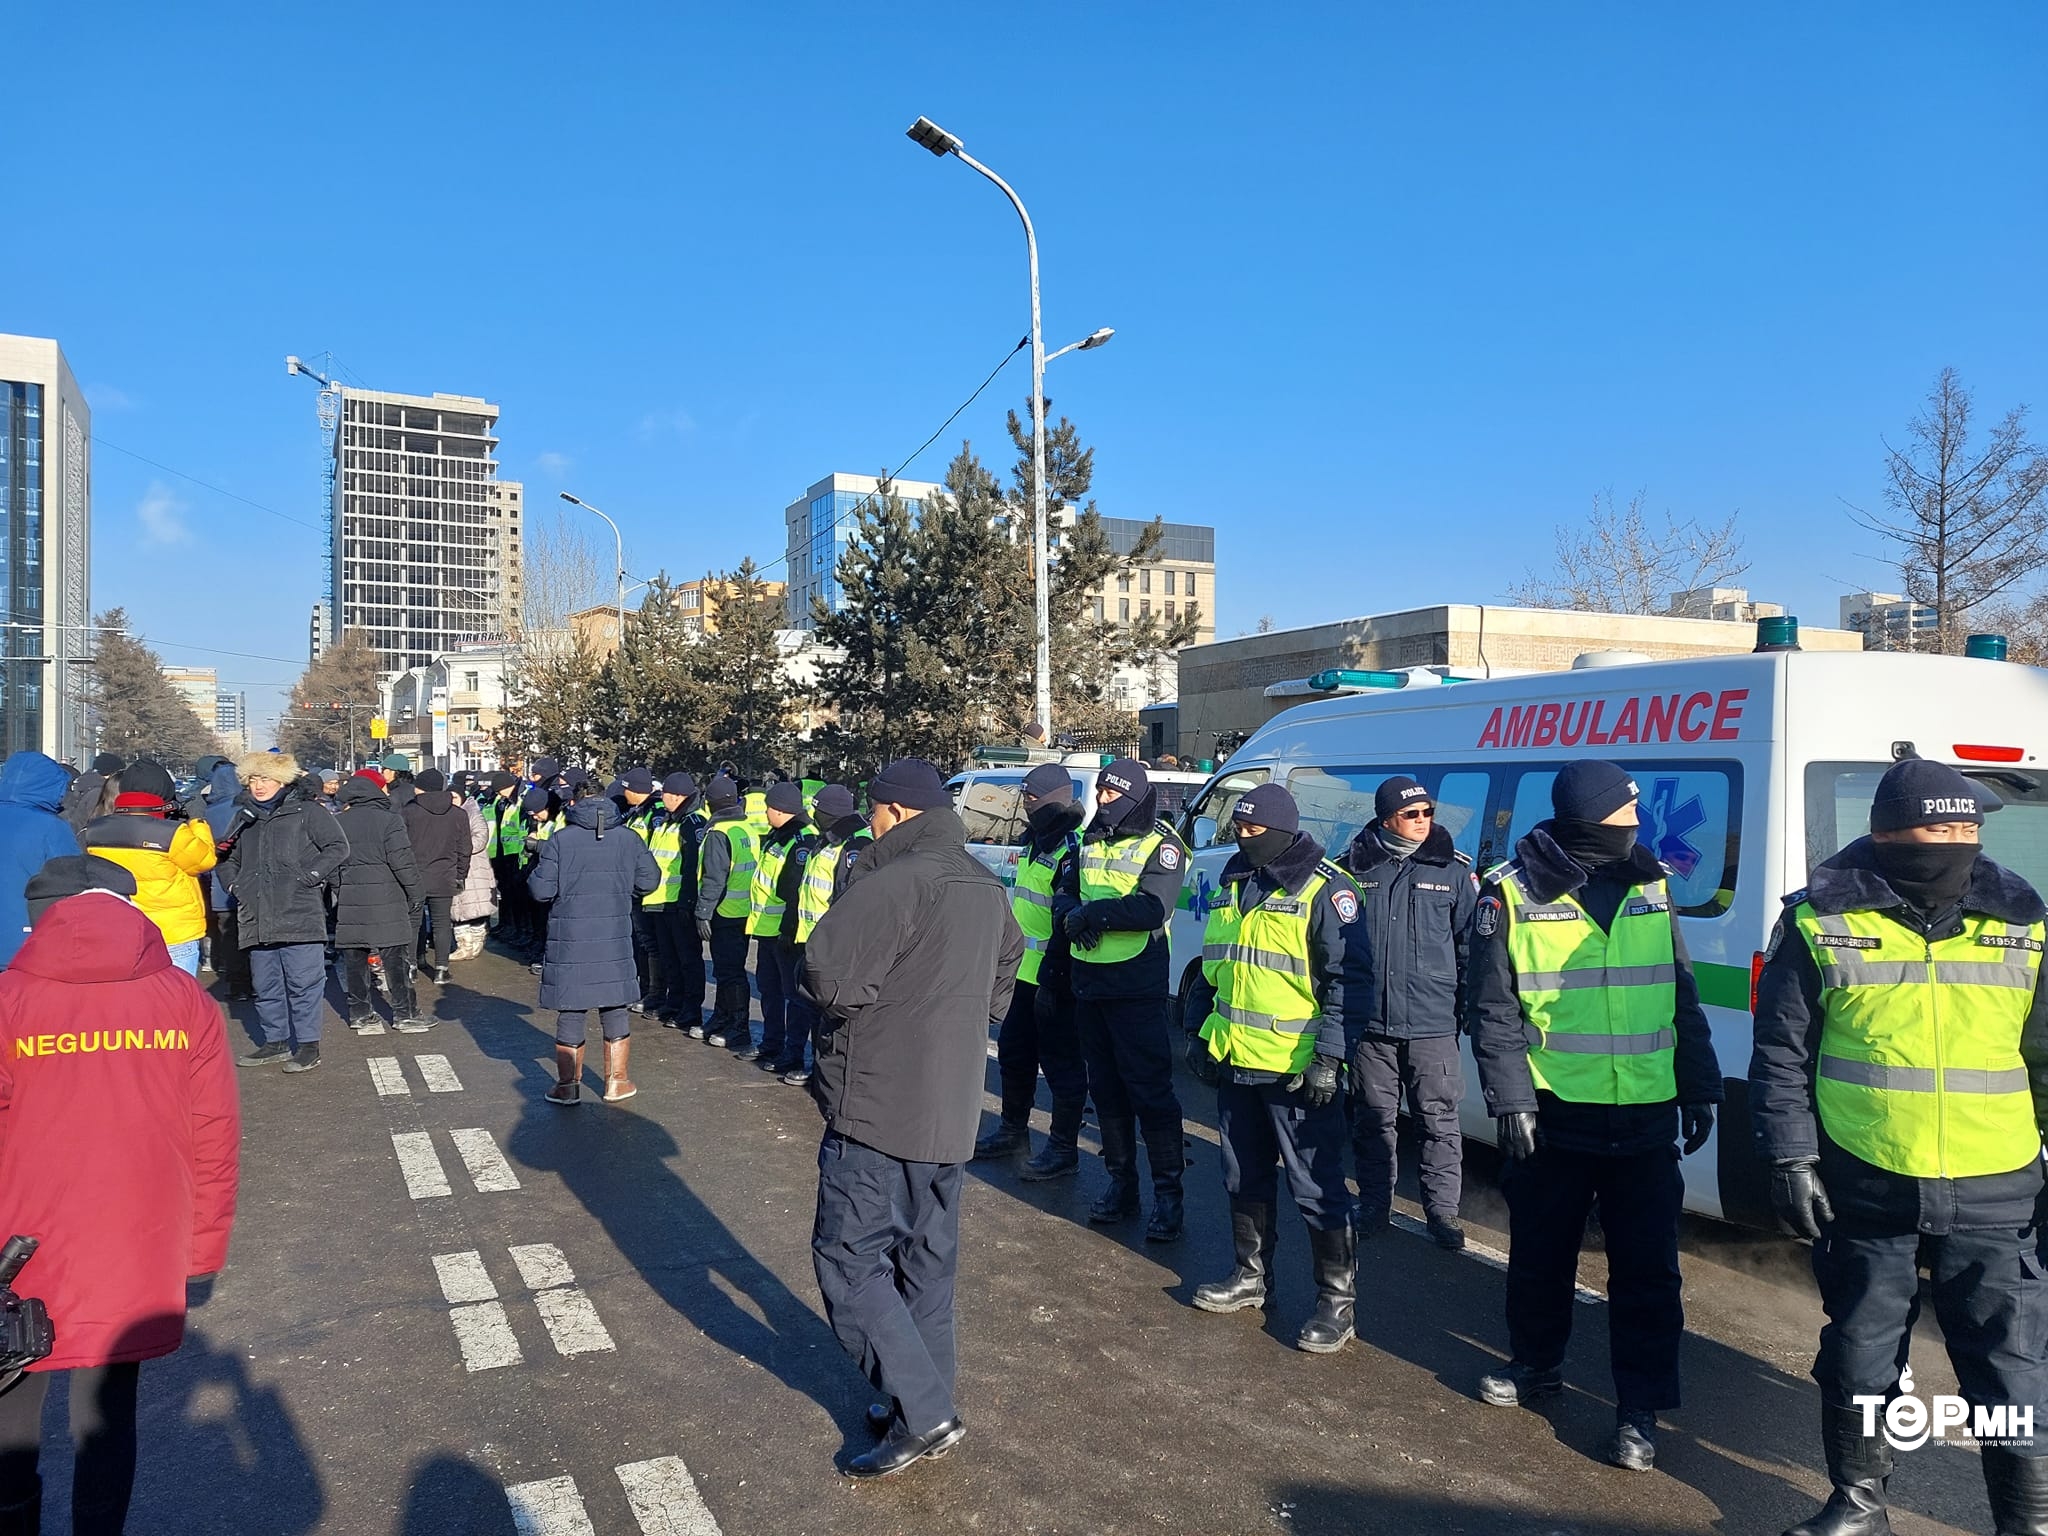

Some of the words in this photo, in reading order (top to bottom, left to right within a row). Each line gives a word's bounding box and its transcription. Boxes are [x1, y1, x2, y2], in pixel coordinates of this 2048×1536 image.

[1477, 689, 1749, 748] AMBULANCE
[1105, 773, 1132, 791] POLICE
[1923, 798, 1976, 814] POLICE
[1983, 936, 2018, 947] 31952
[16, 1028, 189, 1059] NEGUUN.MN
